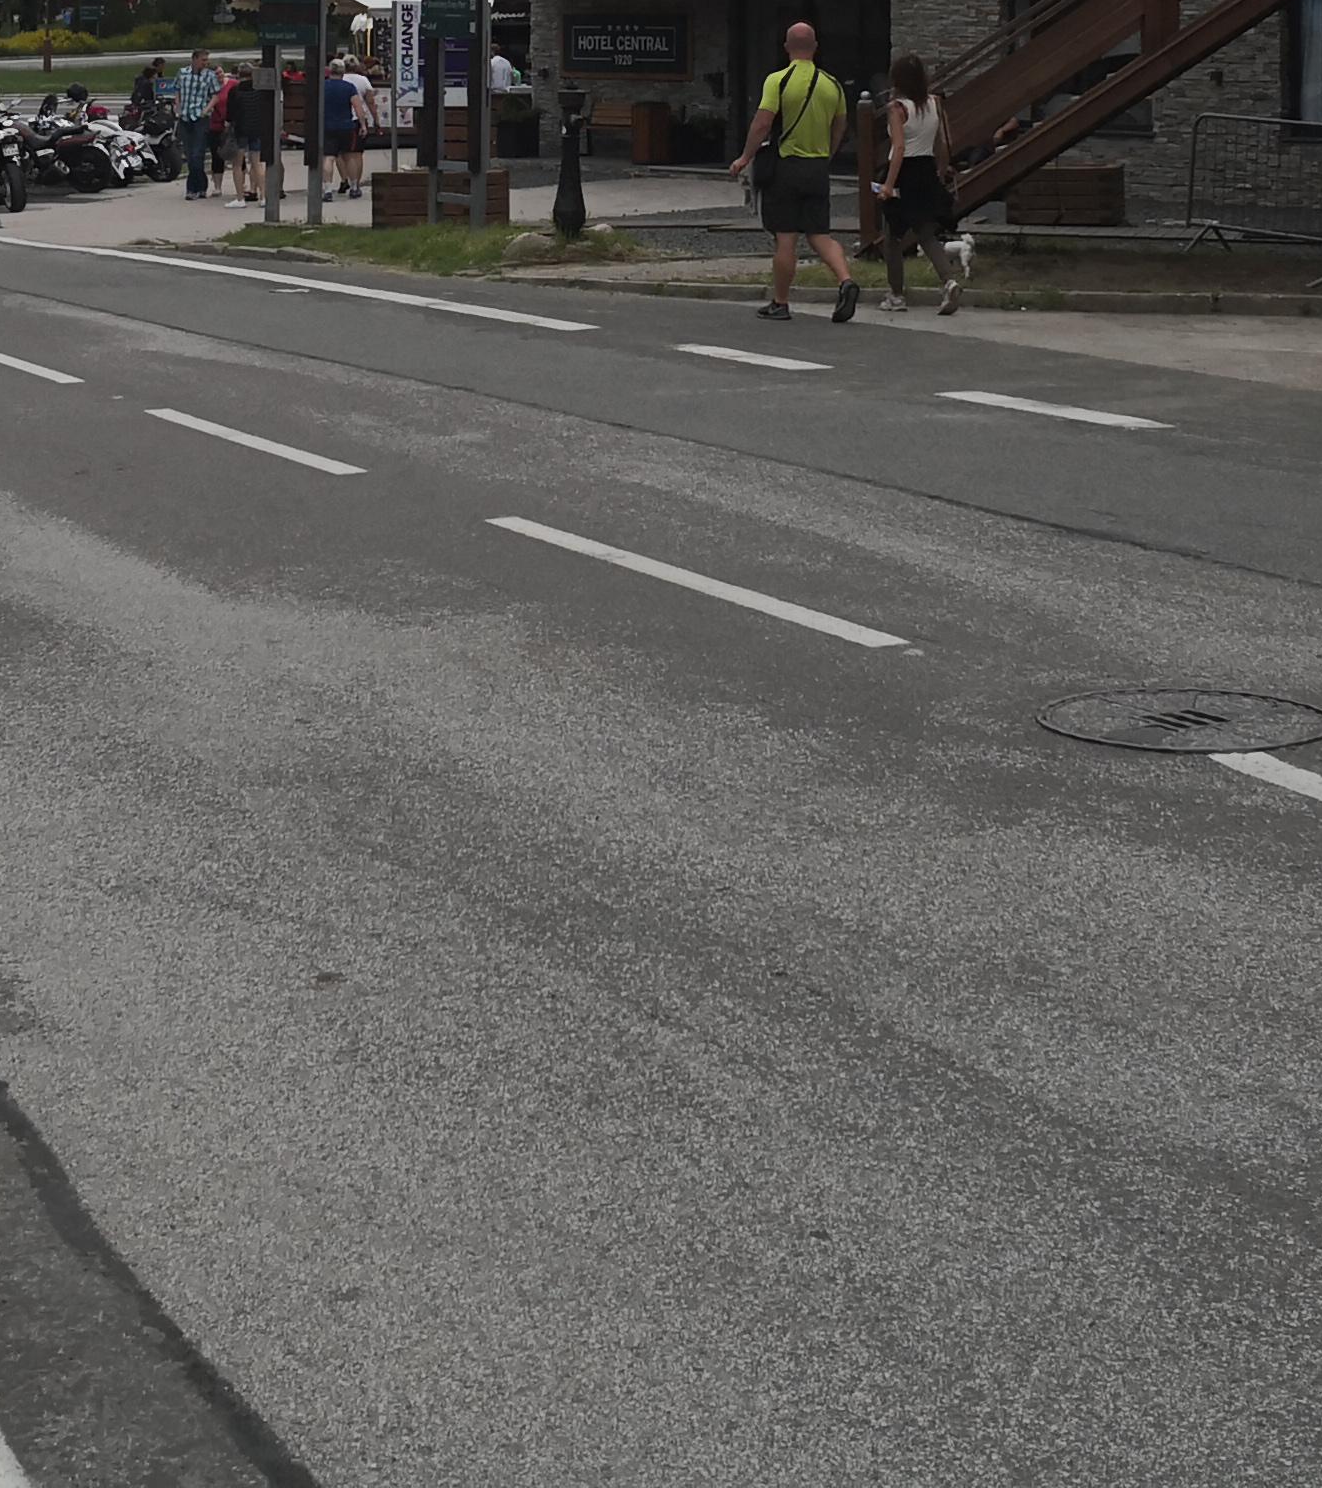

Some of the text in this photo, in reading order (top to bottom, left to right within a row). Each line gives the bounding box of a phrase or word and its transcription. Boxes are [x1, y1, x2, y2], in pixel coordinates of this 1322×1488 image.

[400, 3, 414, 82] EXCHANGE
[578, 36, 669, 51] HOTEL CENTRAL
